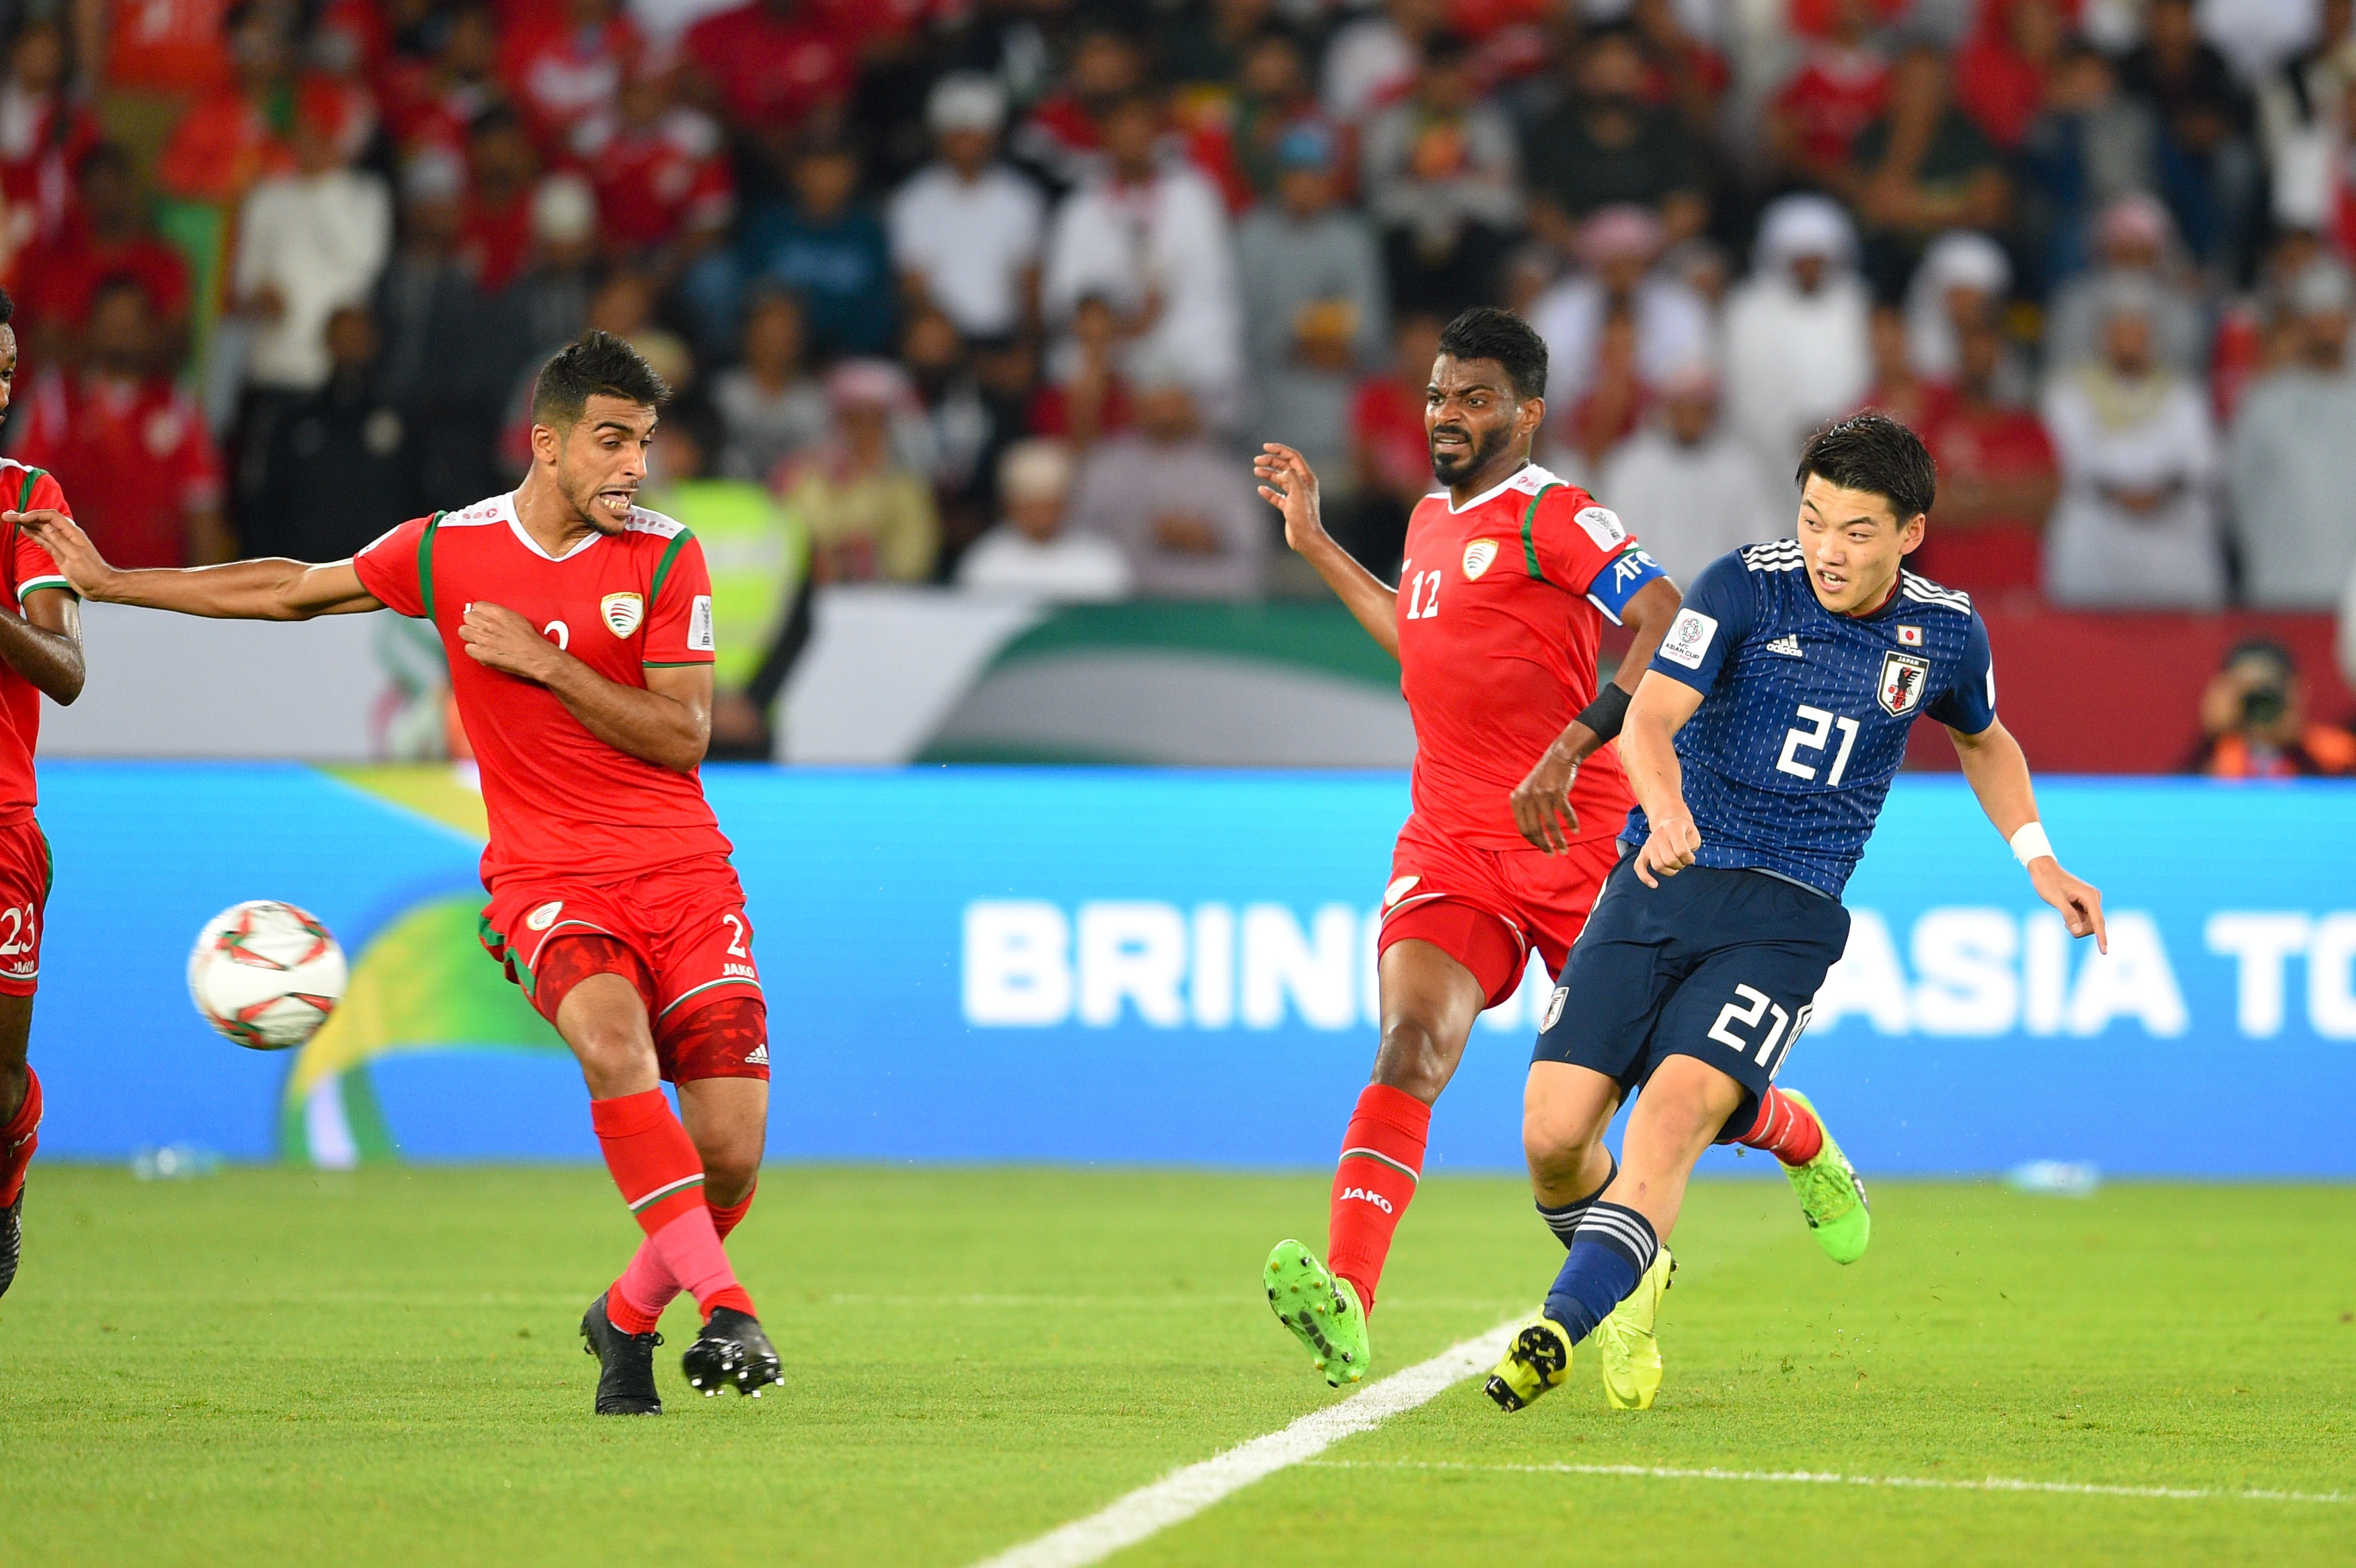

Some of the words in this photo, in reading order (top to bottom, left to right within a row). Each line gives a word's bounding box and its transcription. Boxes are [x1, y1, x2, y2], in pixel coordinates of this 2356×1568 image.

[1613, 551, 1658, 594] AFC
[1407, 570, 1441, 620] 12
[1666, 643, 1685, 654] ASIAN
[1685, 650, 1699, 659] CUP
[1767, 643, 1803, 657] adidas
[1897, 657, 1919, 665] JAPAN
[1776, 705, 1860, 786] 21
[0, 903, 35, 955] 23
[723, 914, 747, 958] 2
[723, 963, 755, 978] JAKO
[1803, 907, 2190, 1037] ASIA
[1707, 983, 1789, 1067] 21
[1339, 1187, 1393, 1214] JAKO
